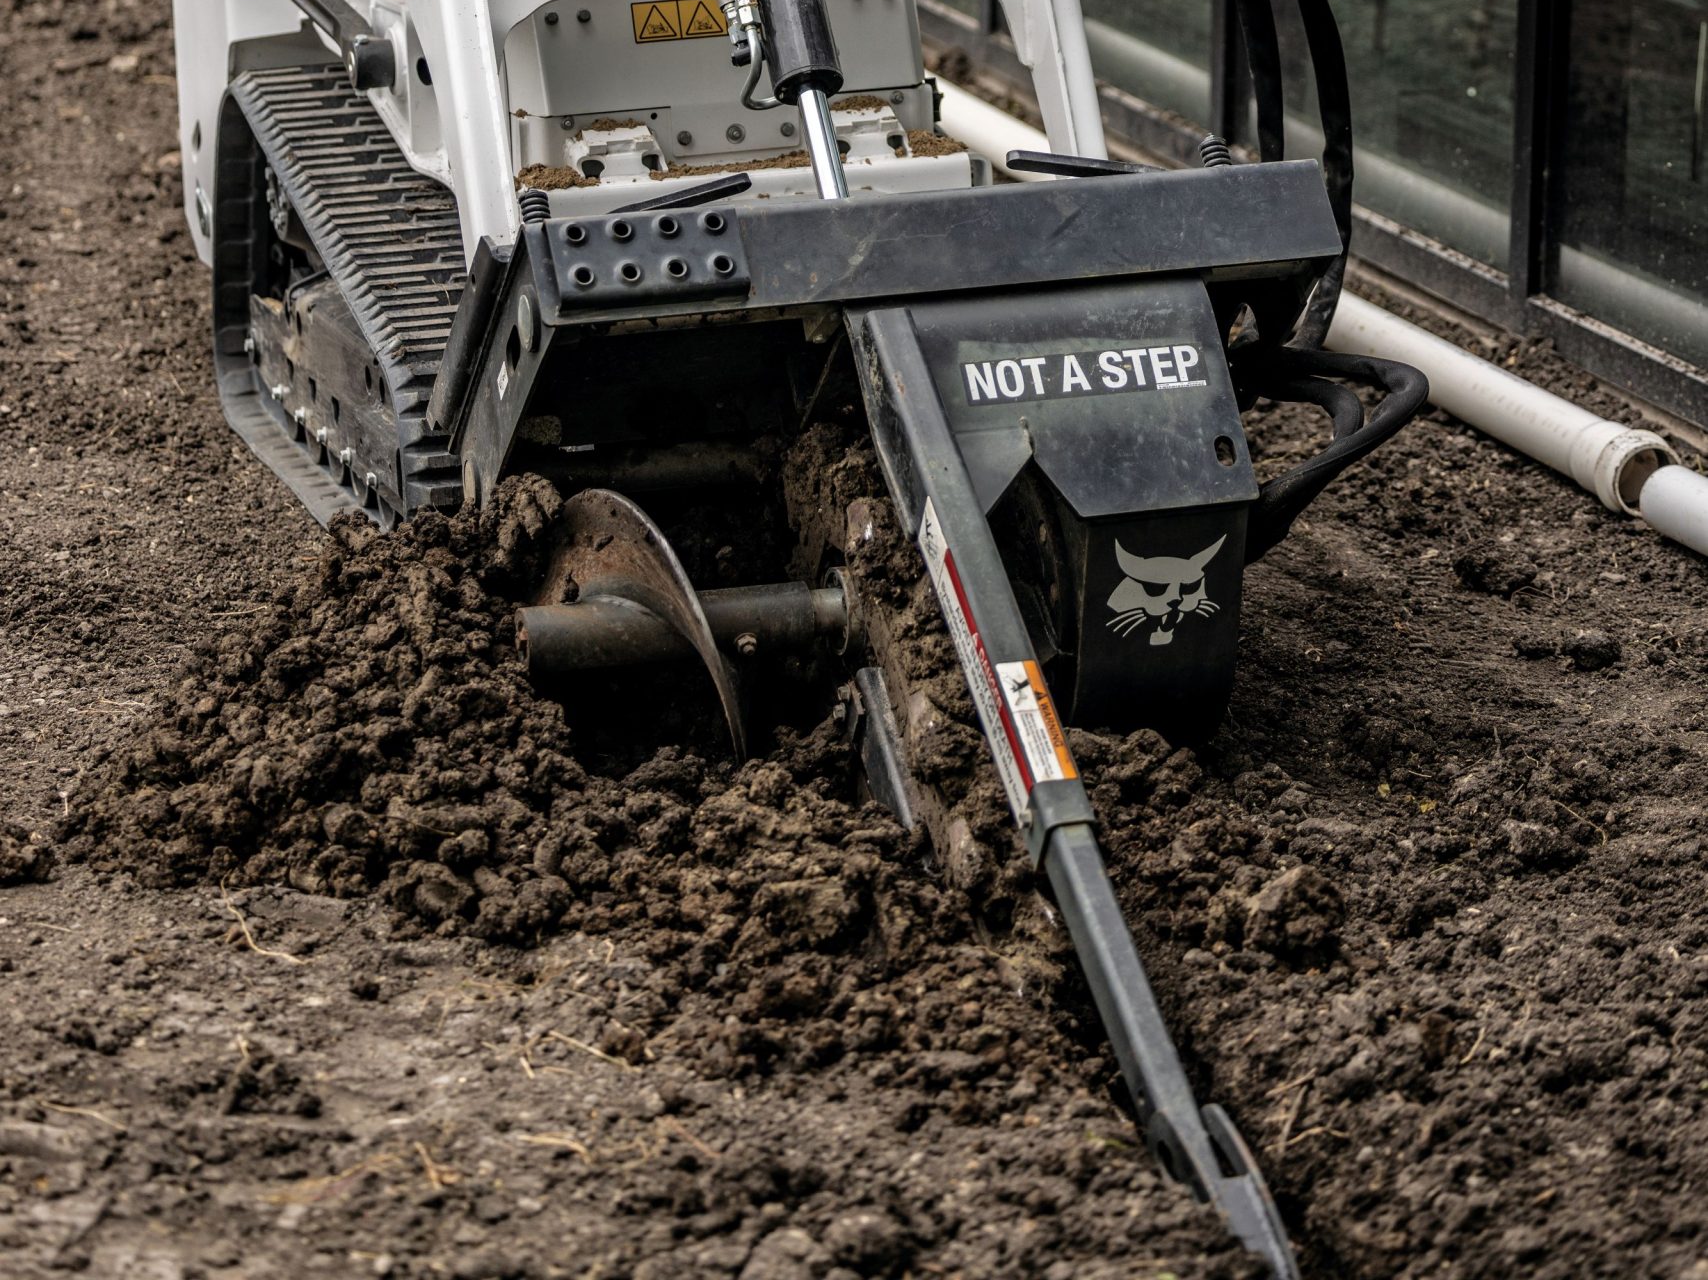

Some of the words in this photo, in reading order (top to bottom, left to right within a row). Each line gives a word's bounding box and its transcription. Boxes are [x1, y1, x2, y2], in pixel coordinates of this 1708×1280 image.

[965, 357, 1046, 401] NOT
[1063, 354, 1092, 393] A
[1098, 345, 1199, 389] STEP
[1040, 703, 1064, 748] WARNING
